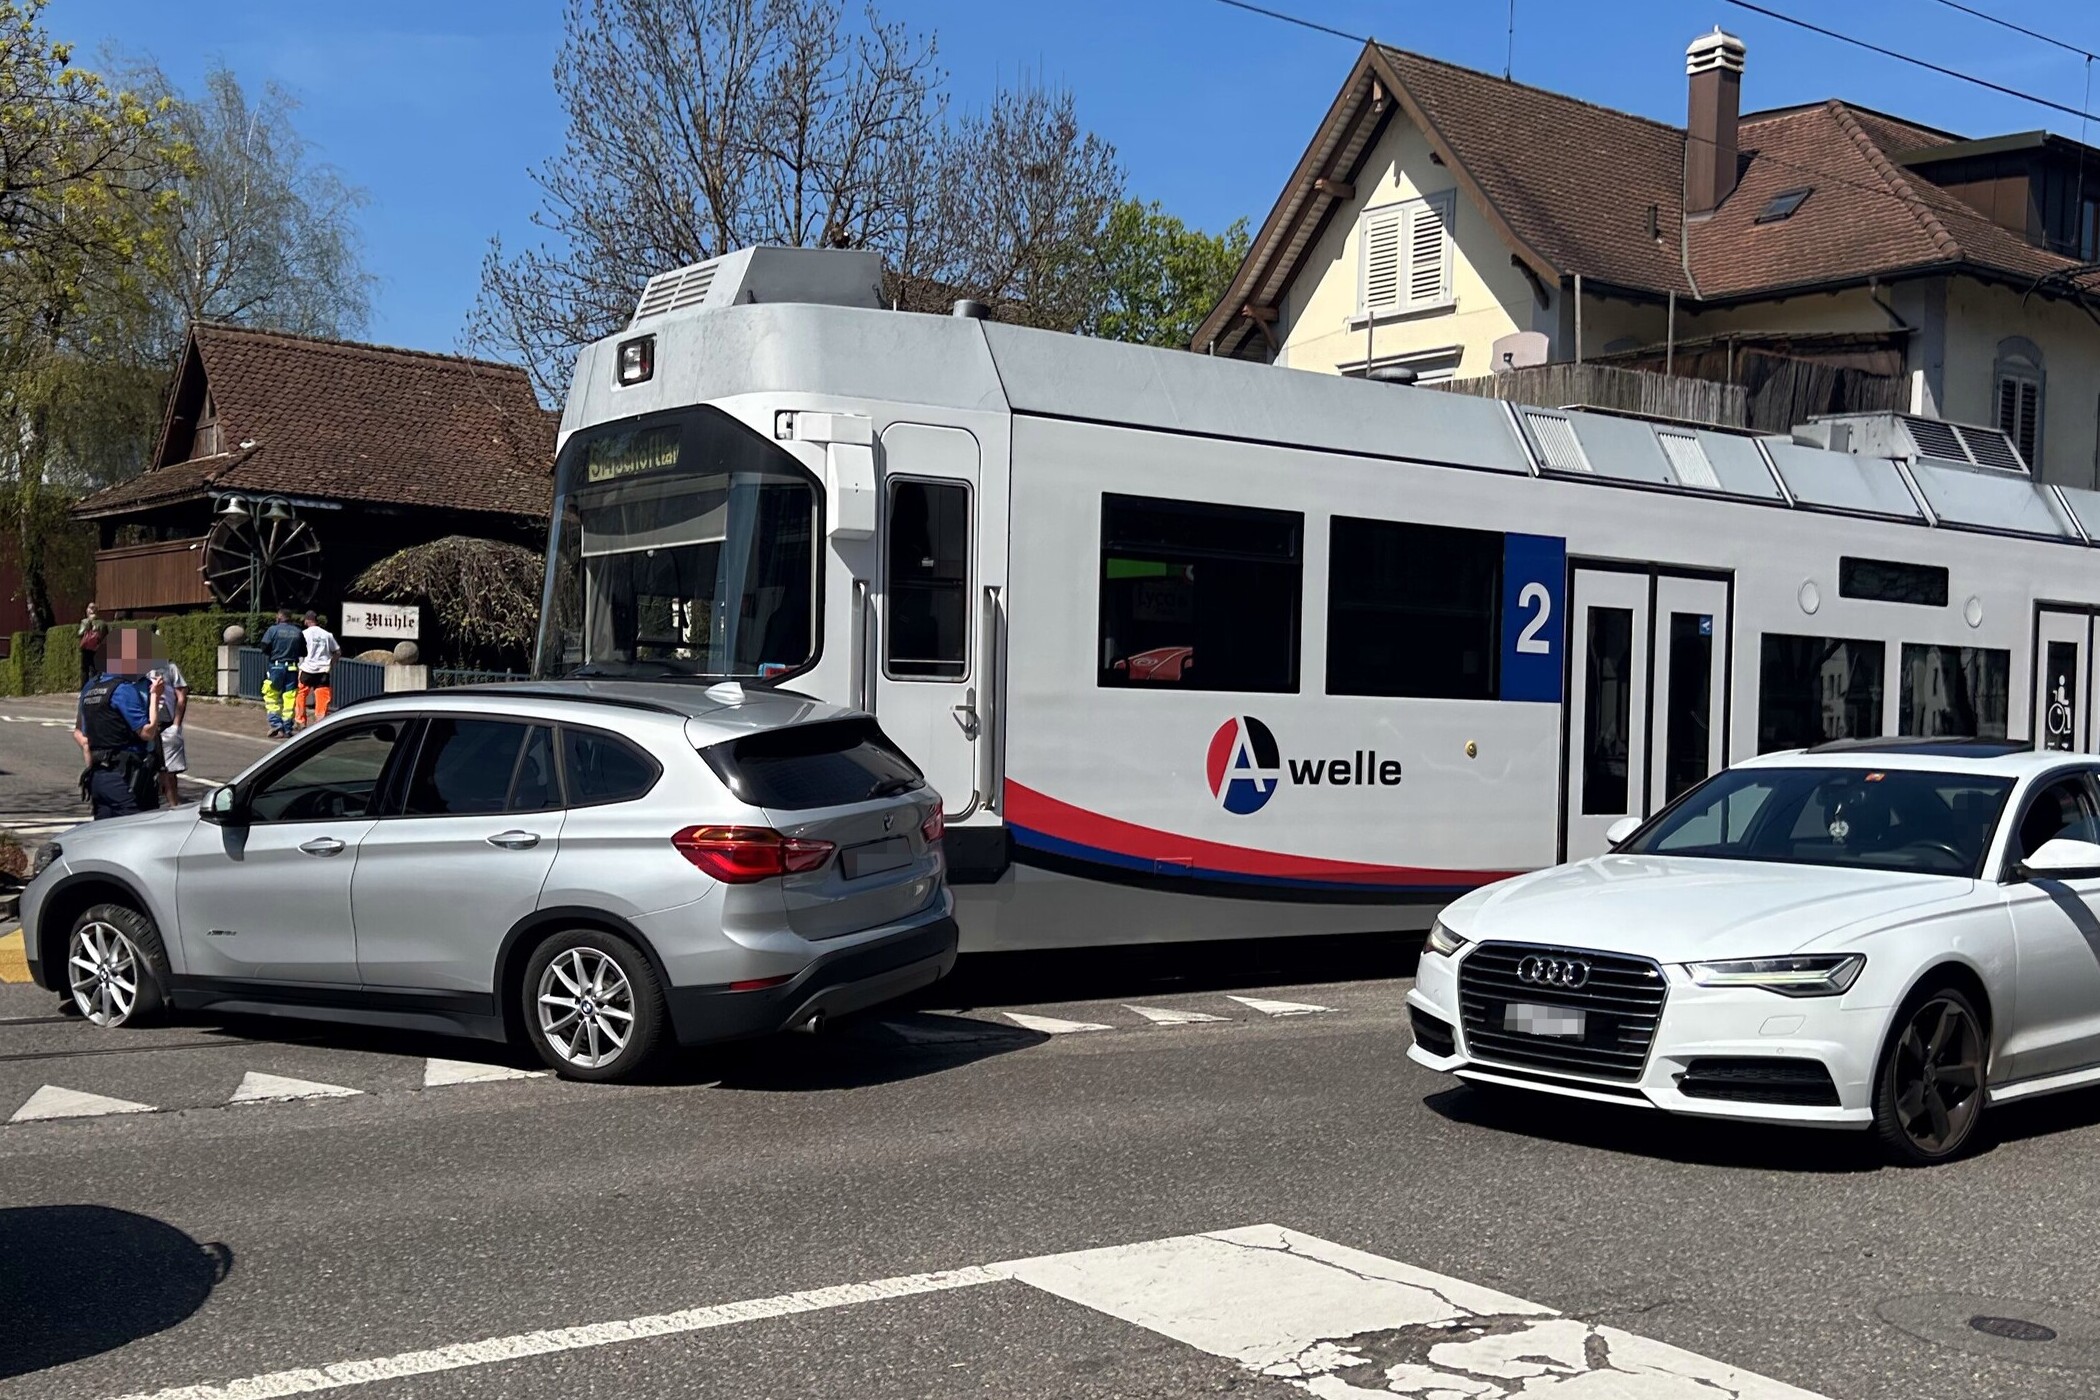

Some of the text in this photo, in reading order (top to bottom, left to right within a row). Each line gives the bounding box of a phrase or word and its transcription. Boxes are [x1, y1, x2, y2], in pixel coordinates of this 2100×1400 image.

[365, 612, 415, 630] Mühle
[1516, 582, 1551, 654] 2
[1288, 750, 1402, 786] welle
